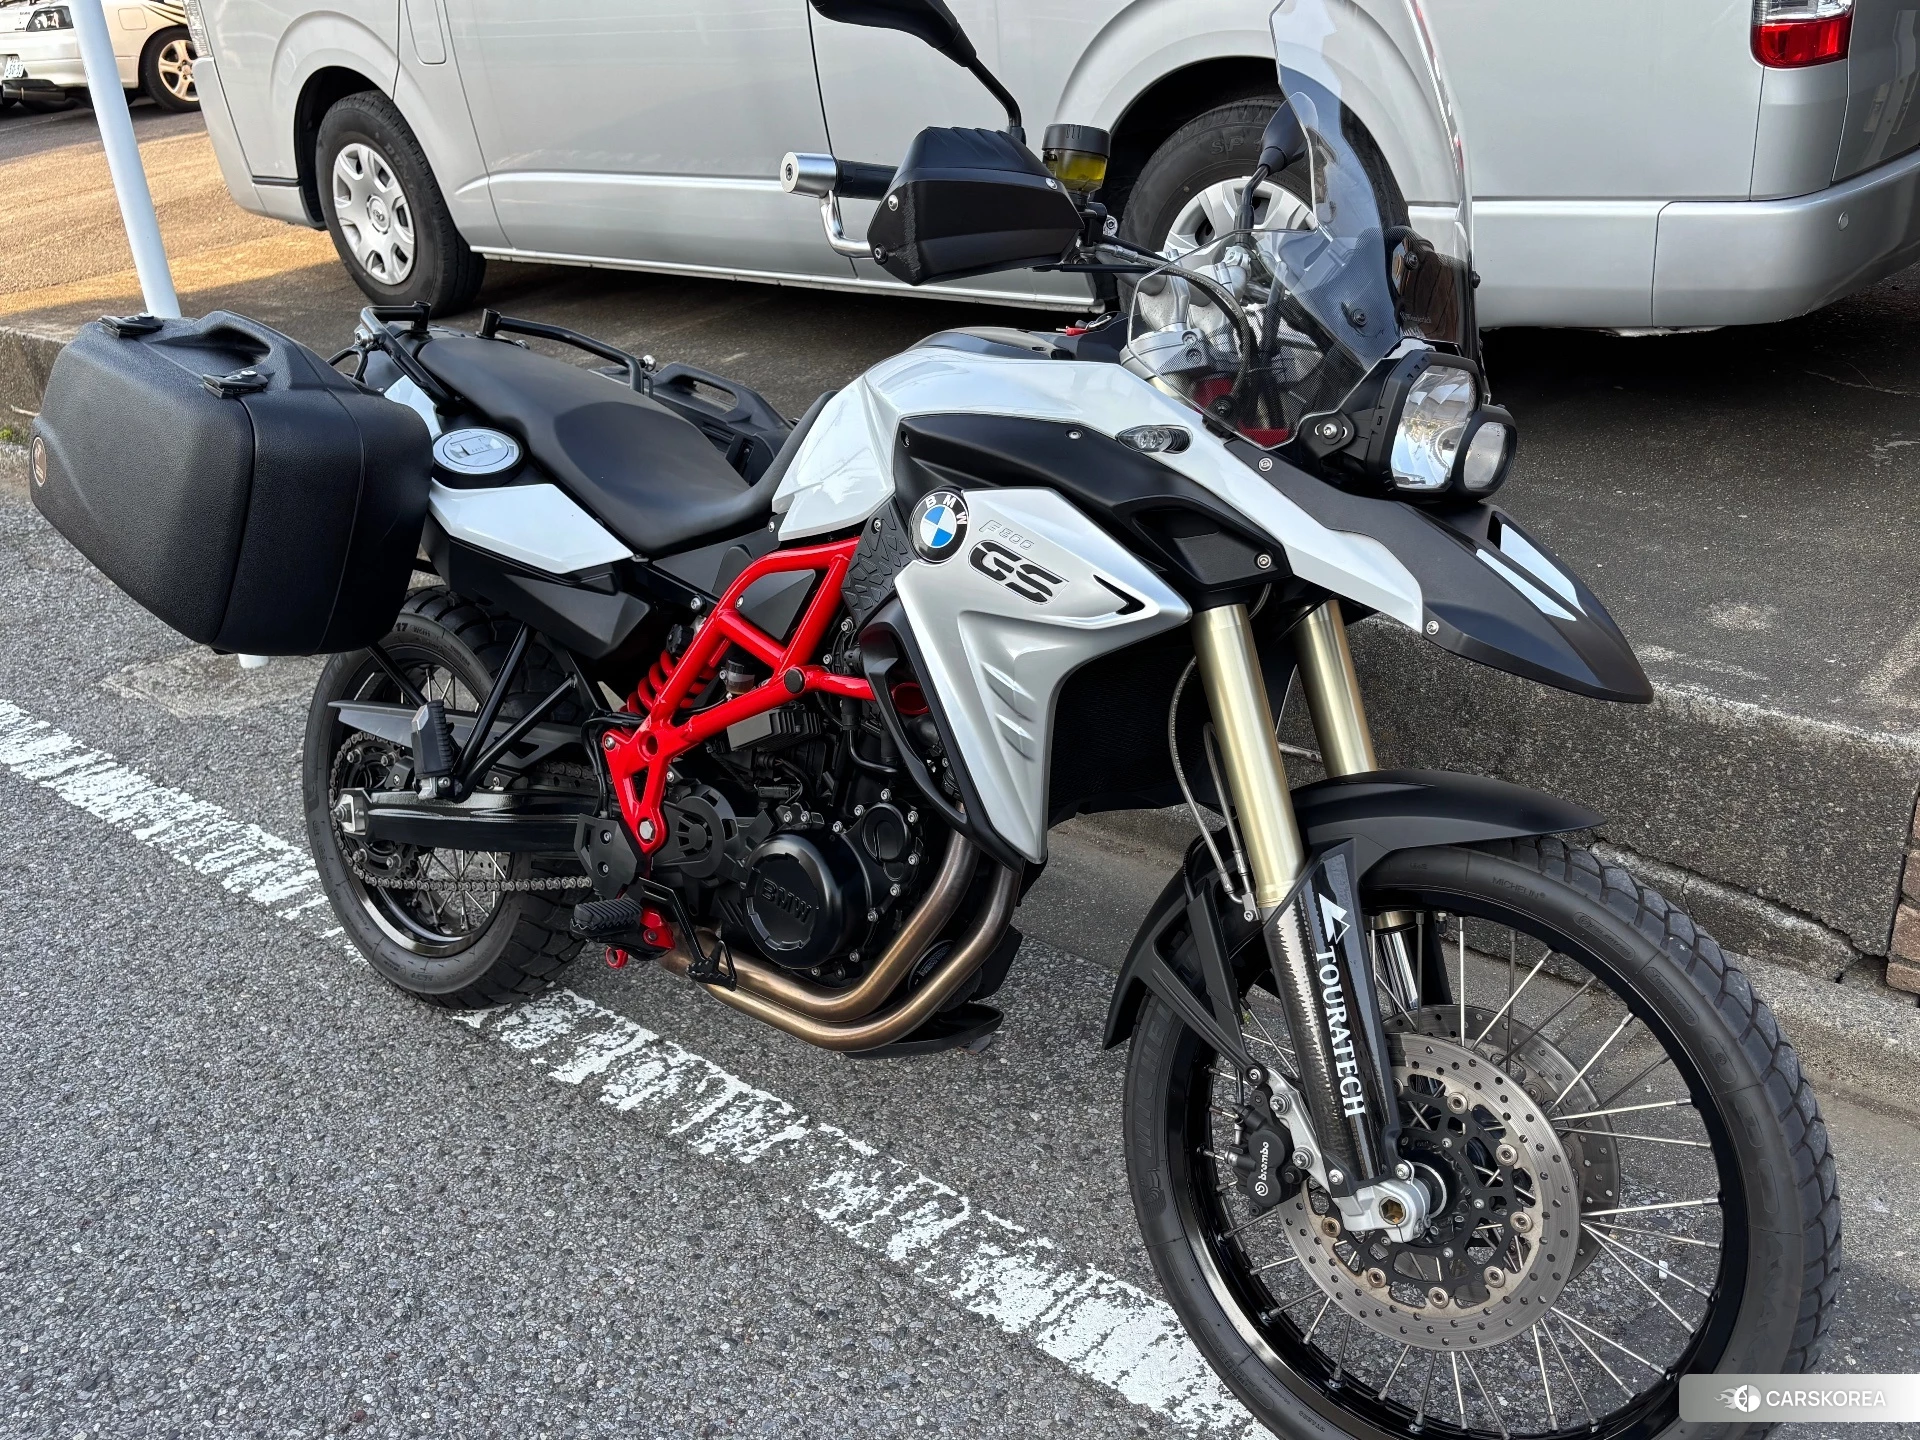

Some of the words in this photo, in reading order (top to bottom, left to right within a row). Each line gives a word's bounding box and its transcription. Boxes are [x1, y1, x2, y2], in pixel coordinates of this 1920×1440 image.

[1210, 135, 1244, 155] SP
[925, 494, 968, 525] BMW
[969, 540, 1063, 603] GS
[761, 877, 812, 924] BMW
[1315, 945, 1366, 1118] TOURATECH
[1257, 1141, 1270, 1181] brembo
